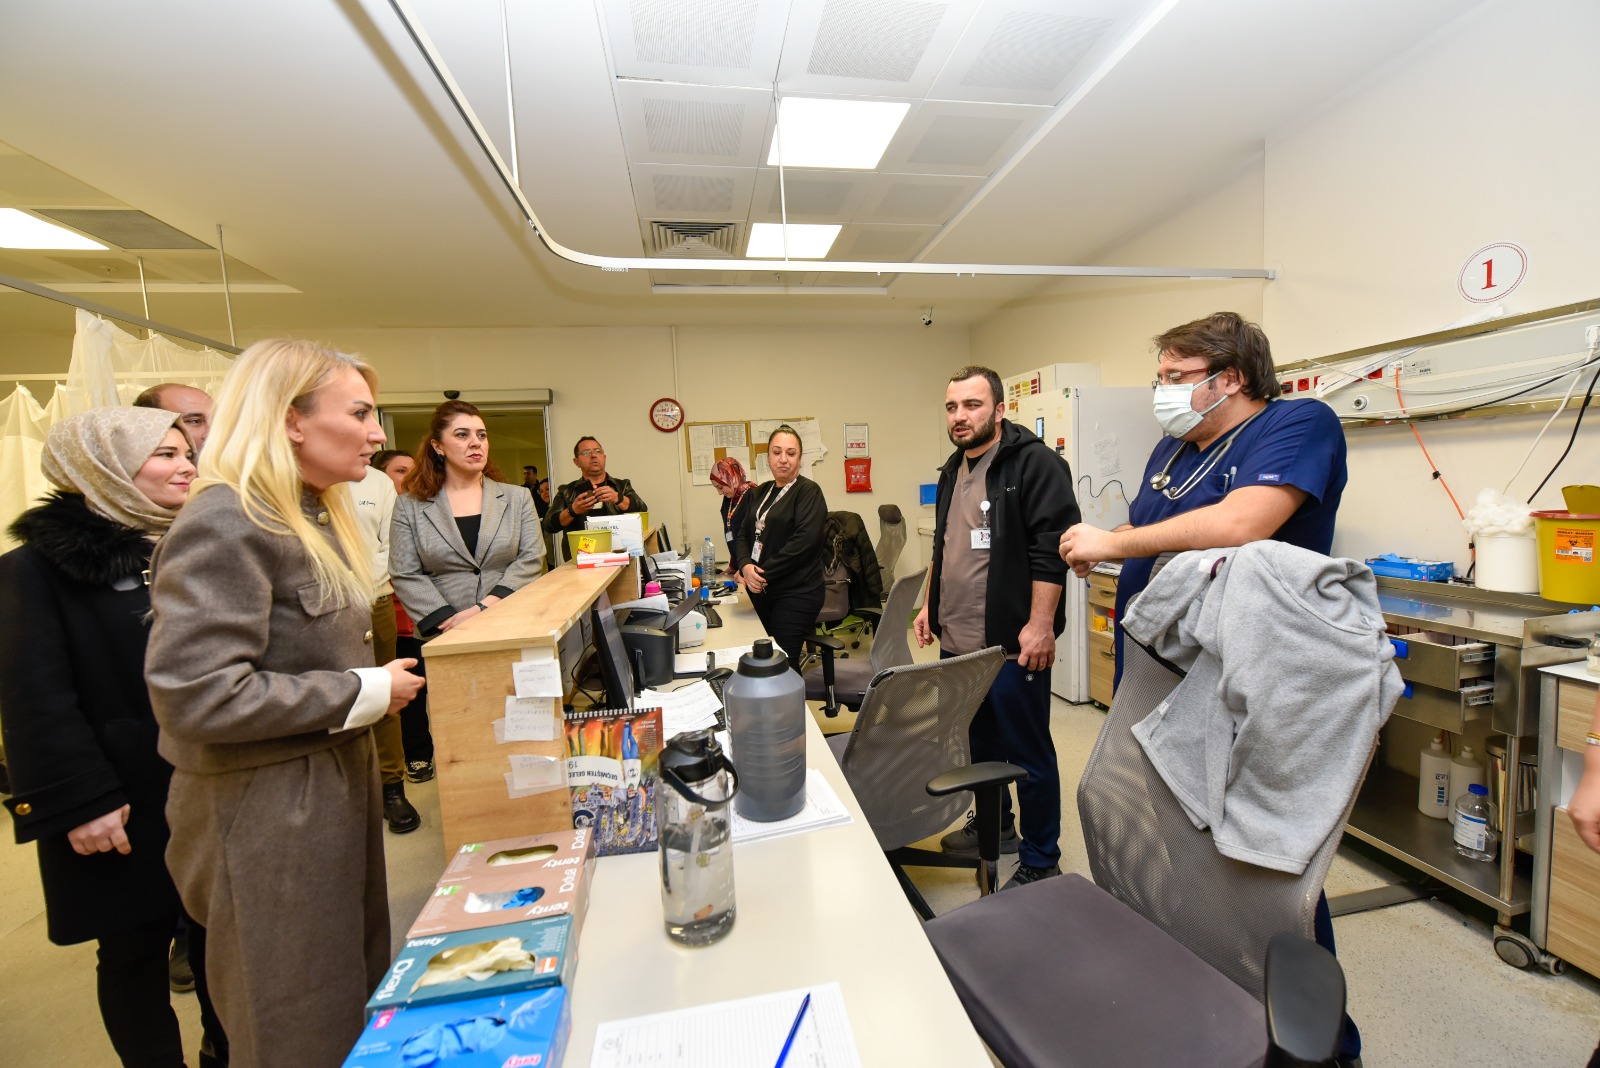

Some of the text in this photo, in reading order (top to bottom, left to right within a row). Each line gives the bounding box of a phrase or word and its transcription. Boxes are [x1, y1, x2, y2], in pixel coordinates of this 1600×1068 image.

[1481, 258, 1497, 290] 1
[541, 856, 581, 869] tenty
[526, 901, 569, 917] tenty
